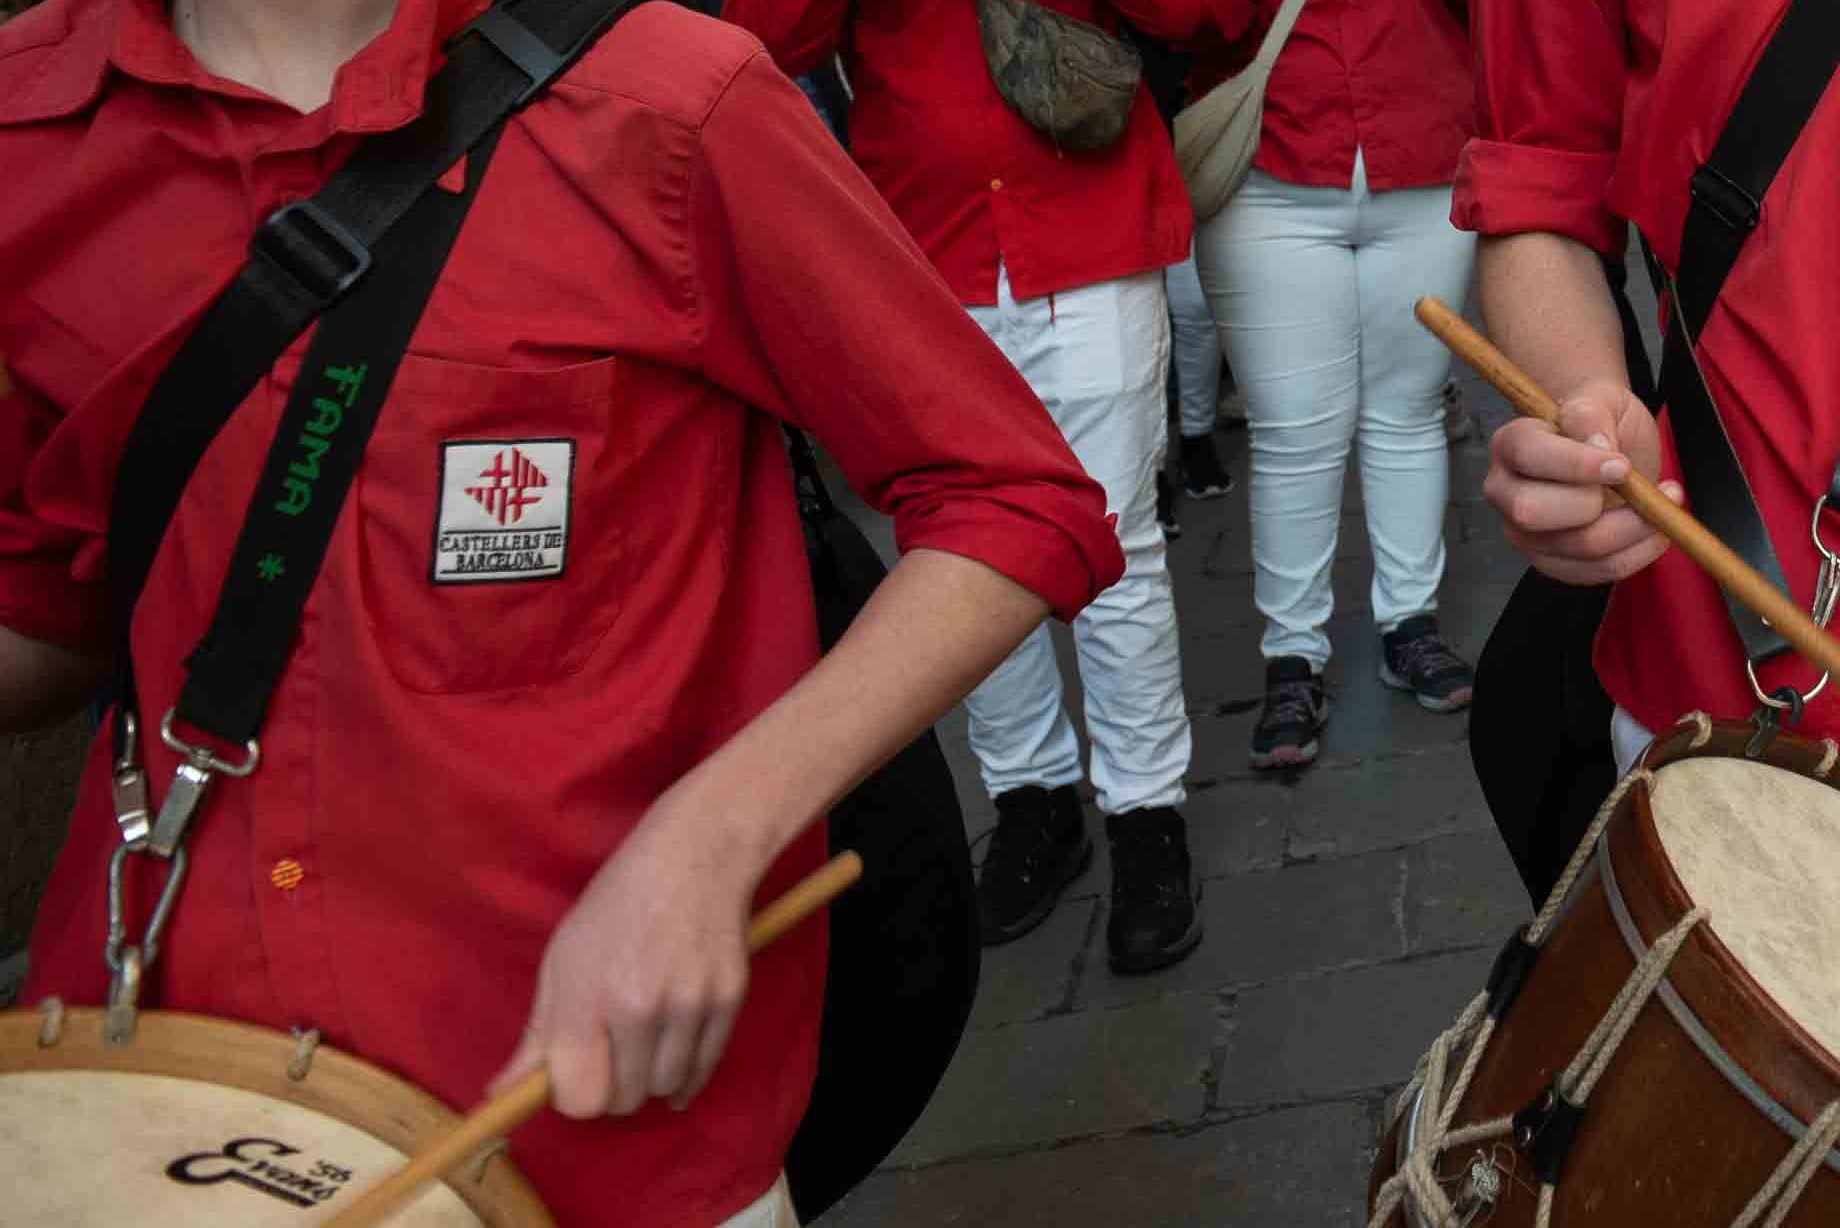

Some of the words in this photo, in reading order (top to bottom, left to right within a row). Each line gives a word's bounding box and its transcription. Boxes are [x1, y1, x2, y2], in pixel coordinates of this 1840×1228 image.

[273, 363, 368, 517] FAMA
[439, 533, 541, 553] CASTELLERS
[543, 532, 563, 549] DE
[455, 550, 545, 572] BARCELONA
